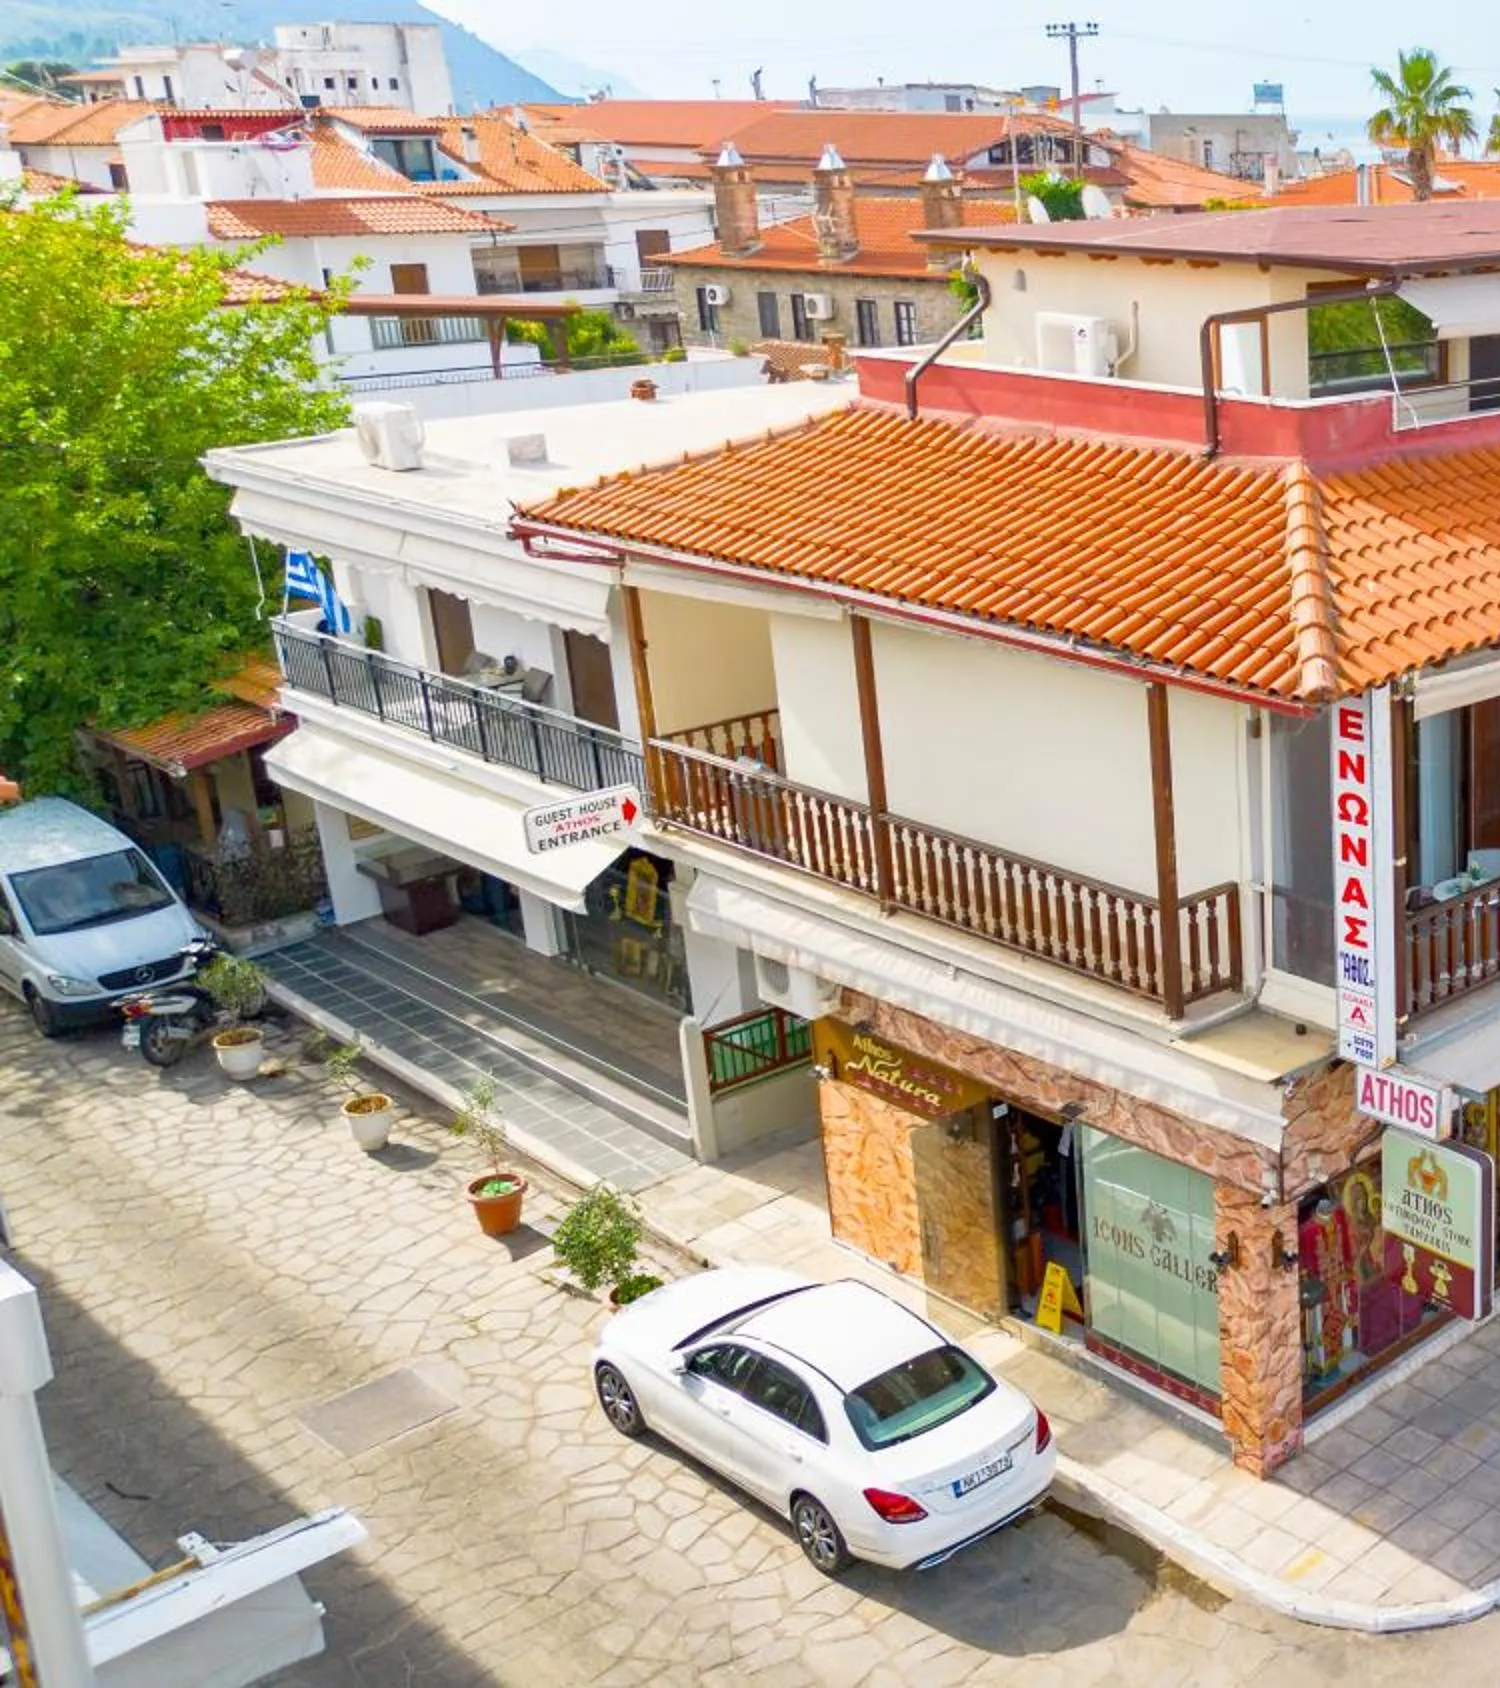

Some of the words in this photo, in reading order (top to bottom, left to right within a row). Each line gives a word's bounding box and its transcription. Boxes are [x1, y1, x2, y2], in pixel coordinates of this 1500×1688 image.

[535, 807, 573, 827] GUEST
[579, 796, 617, 815] HOUSE
[555, 815, 601, 833] ATHOS
[1337, 689, 1369, 949] ΕΝΩΝΑΣ
[538, 820, 621, 851] ENTRANCE
[852, 1034, 893, 1061] Athos
[844, 1054, 941, 1107] Natura
[1360, 1073, 1434, 1129] ATHOS
[1402, 1189, 1453, 1225] ATHOS
[1093, 1215, 1145, 1259] ICONS
[1150, 1244, 1218, 1295] GALLER
